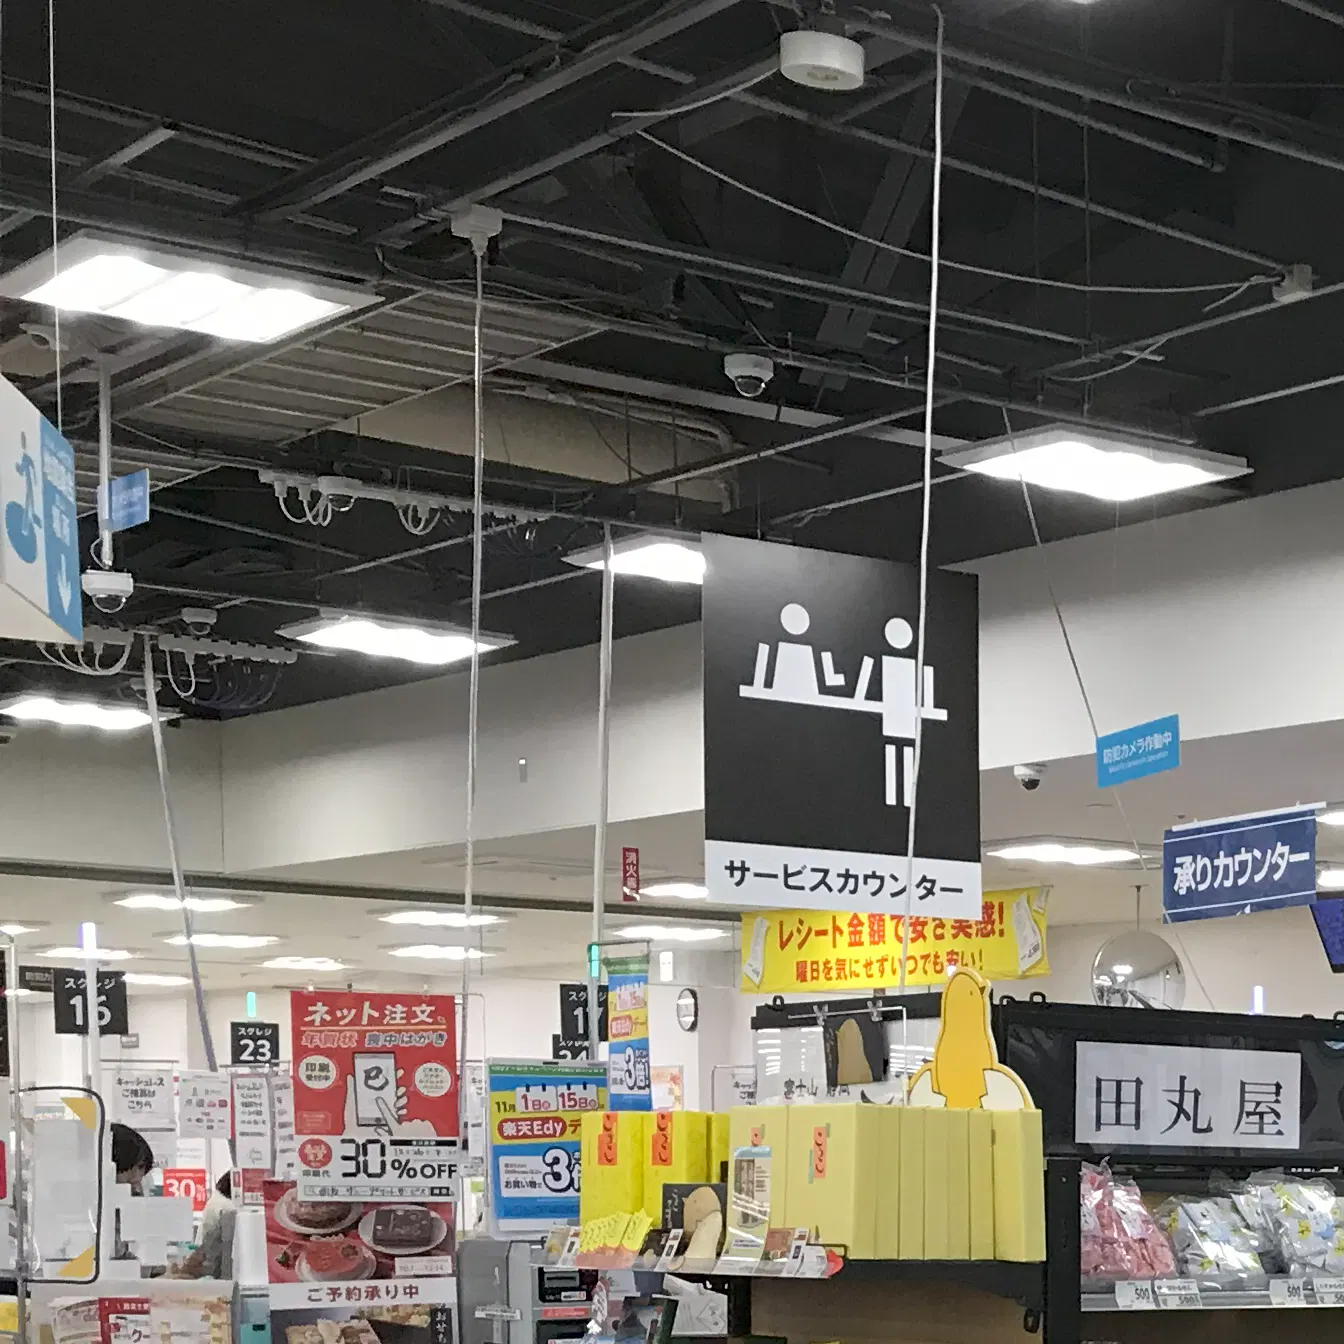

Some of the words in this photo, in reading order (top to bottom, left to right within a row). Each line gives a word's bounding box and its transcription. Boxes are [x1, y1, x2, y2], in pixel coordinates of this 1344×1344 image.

[1103, 731, 1172, 764] 防犯カメラ作動中
[1174, 842, 1309, 895] 承りカウンター
[724, 860, 963, 900] サービスカウンター
[65, 977, 115, 989] スクジ
[238, 1027, 272, 1036] スクレジ
[301, 1031, 357, 1047] 年賀状
[366, 1031, 447, 1047] 喪中はがき
[239, 1040, 271, 1060] 23
[306, 1063, 329, 1072] 印刷
[495, 1101, 515, 1113] 11月
[1095, 1075, 1285, 1136] 田丸屋
[503, 1119, 562, 1137] 楽天Edy
[307, 1284, 420, 1302] ご予約承り中
[1135, 1287, 1150, 1300] 500
[1287, 1286, 1300, 1298] 500
[435, 1312, 448, 1344] おせち
